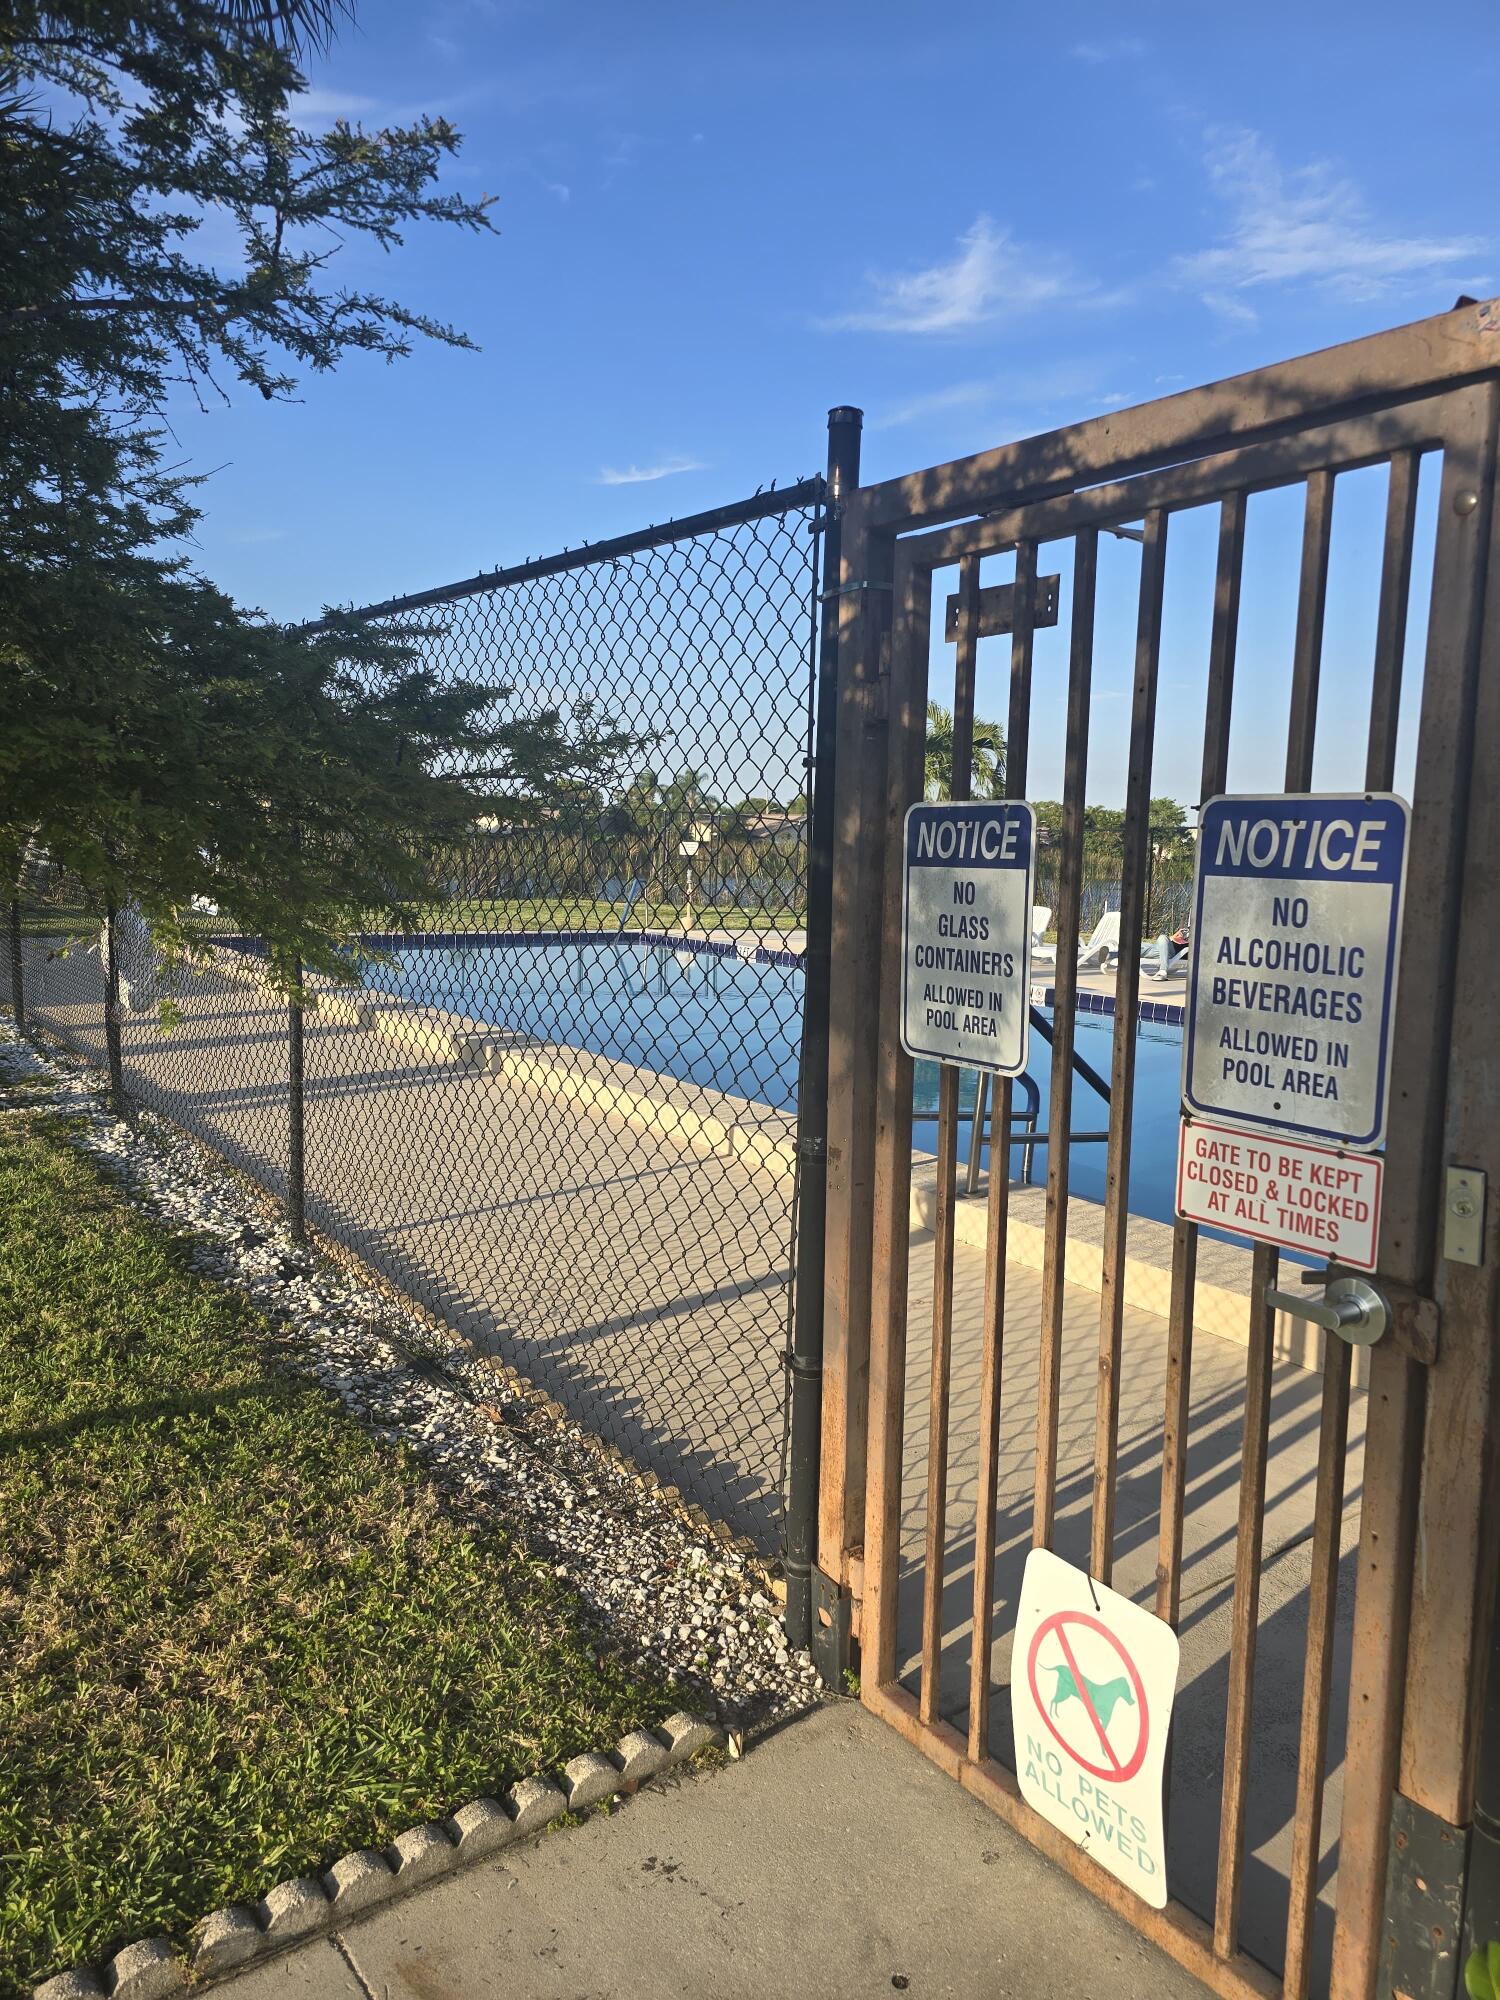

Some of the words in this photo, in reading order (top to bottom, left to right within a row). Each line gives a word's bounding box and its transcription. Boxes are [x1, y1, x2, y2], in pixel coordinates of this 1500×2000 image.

[916, 820, 1021, 860] NOTICE
[1214, 819, 1387, 872] NOTICE
[953, 881, 976, 905] NO
[1272, 897, 1309, 928] NO
[938, 913, 989, 941] GLASS
[915, 945, 1014, 978] CONTAINERS
[1217, 936, 1365, 979] ALCOHOLIC
[924, 984, 984, 1009] ALLOWED
[989, 992, 1002, 1012] IN
[1212, 977, 1363, 1024] BEVERAGES
[926, 1009, 958, 1031] POOL
[963, 1017, 997, 1038] AREA
[1219, 1026, 1318, 1063] ALLOWED
[1326, 1041, 1349, 1068] IN
[1222, 1057, 1274, 1089] POOL
[1281, 1069, 1339, 1100] AREA
[1195, 1138, 1241, 1166] GATE
[1247, 1149, 1271, 1173] TO
[1278, 1156, 1303, 1180] BE
[1310, 1163, 1363, 1194] KEPT
[1187, 1160, 1258, 1195] CLOSED
[1265, 1179, 1279, 1201] &
[1287, 1184, 1369, 1223] LOCKED
[1207, 1191, 1230, 1213] AT
[1235, 1198, 1270, 1224] ALL
[1276, 1207, 1340, 1243] TIMES
[1026, 1734, 1063, 1777] NO
[1079, 1773, 1148, 1844] PETS
[1025, 1760, 1156, 1876] ALLOWED
